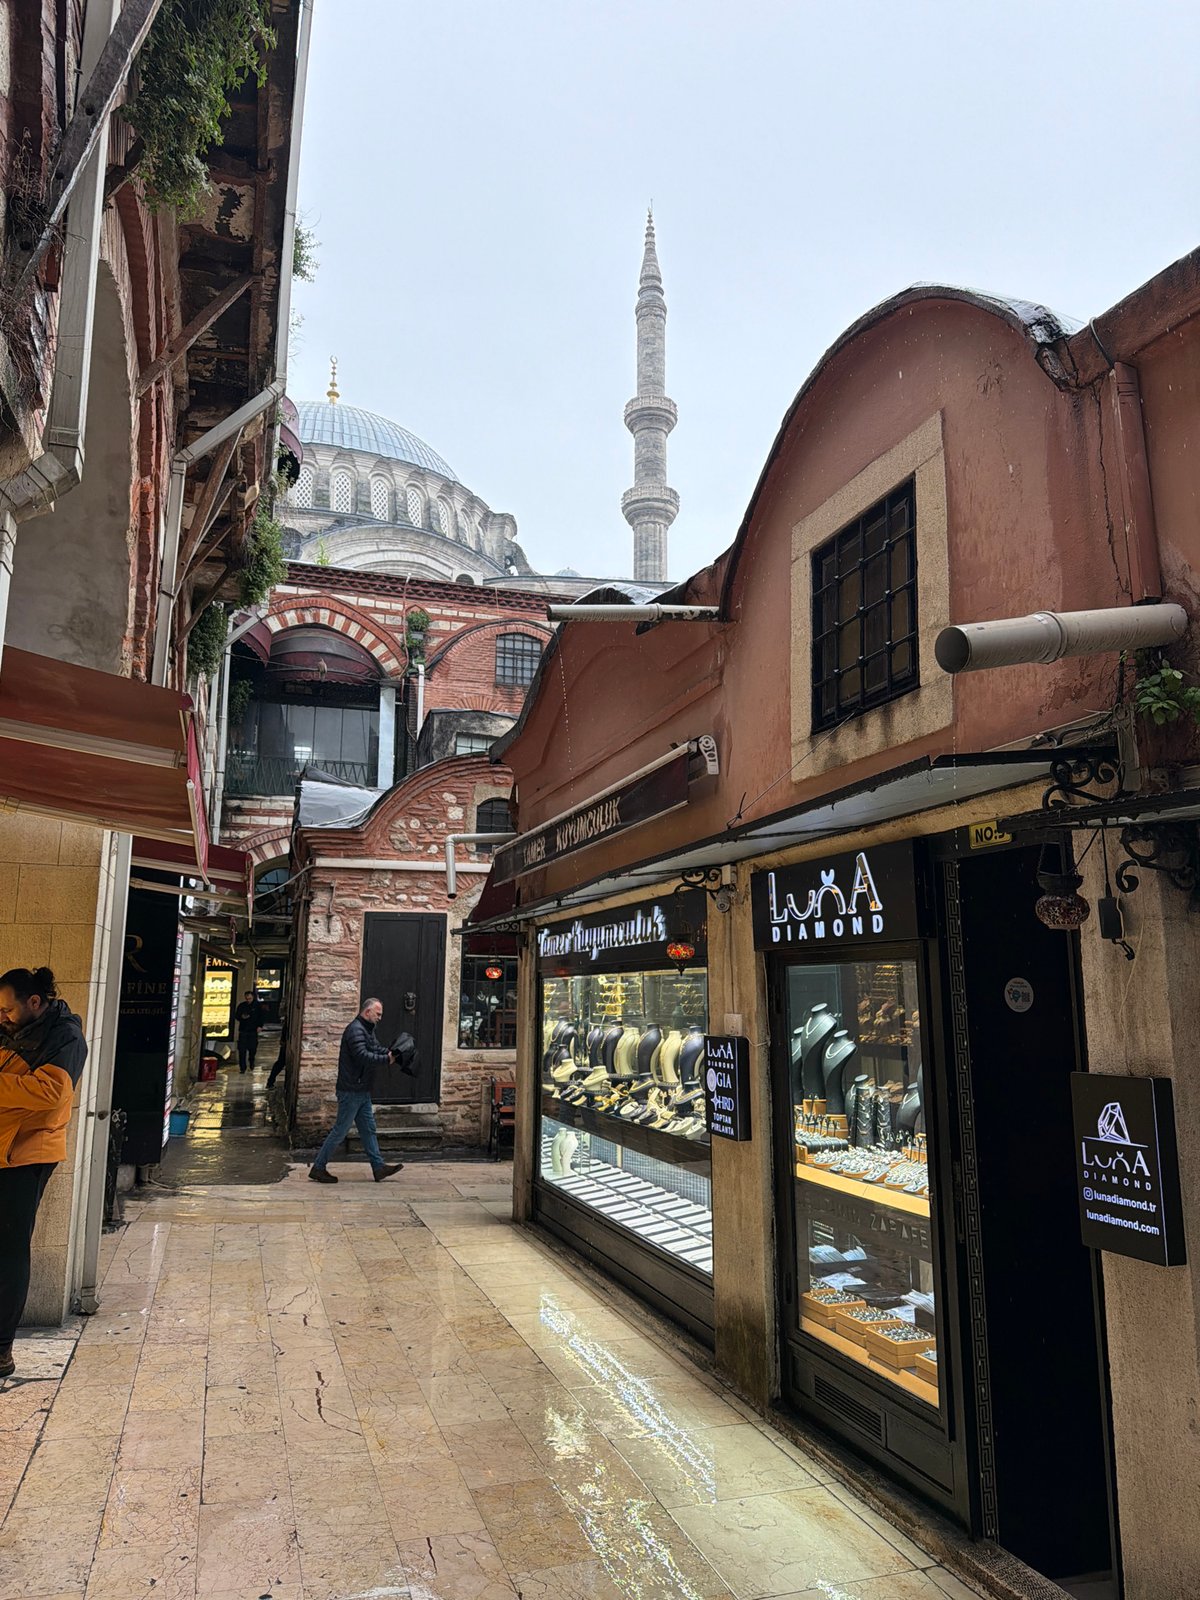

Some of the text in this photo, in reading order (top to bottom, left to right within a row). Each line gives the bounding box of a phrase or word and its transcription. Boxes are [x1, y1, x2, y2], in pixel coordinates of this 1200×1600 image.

[523, 796, 622, 866] TAMER KUYUMCULUK
[537, 904, 667, 961] Tamer Kuyumculuk
[771, 914, 884, 943] DIAMOND
[707, 1060, 734, 1070] DIAMOND
[716, 1071, 732, 1089] GIA
[718, 1095, 735, 1112] HRD
[711, 1122, 735, 1136] PIRLANTA
[713, 1112, 732, 1125] TOPTAN
[1083, 1170, 1152, 1191] DIAMOND
[1093, 1189, 1157, 1213] lunadiamond.tr
[1086, 1208, 1160, 1236] lunadiamond.com
